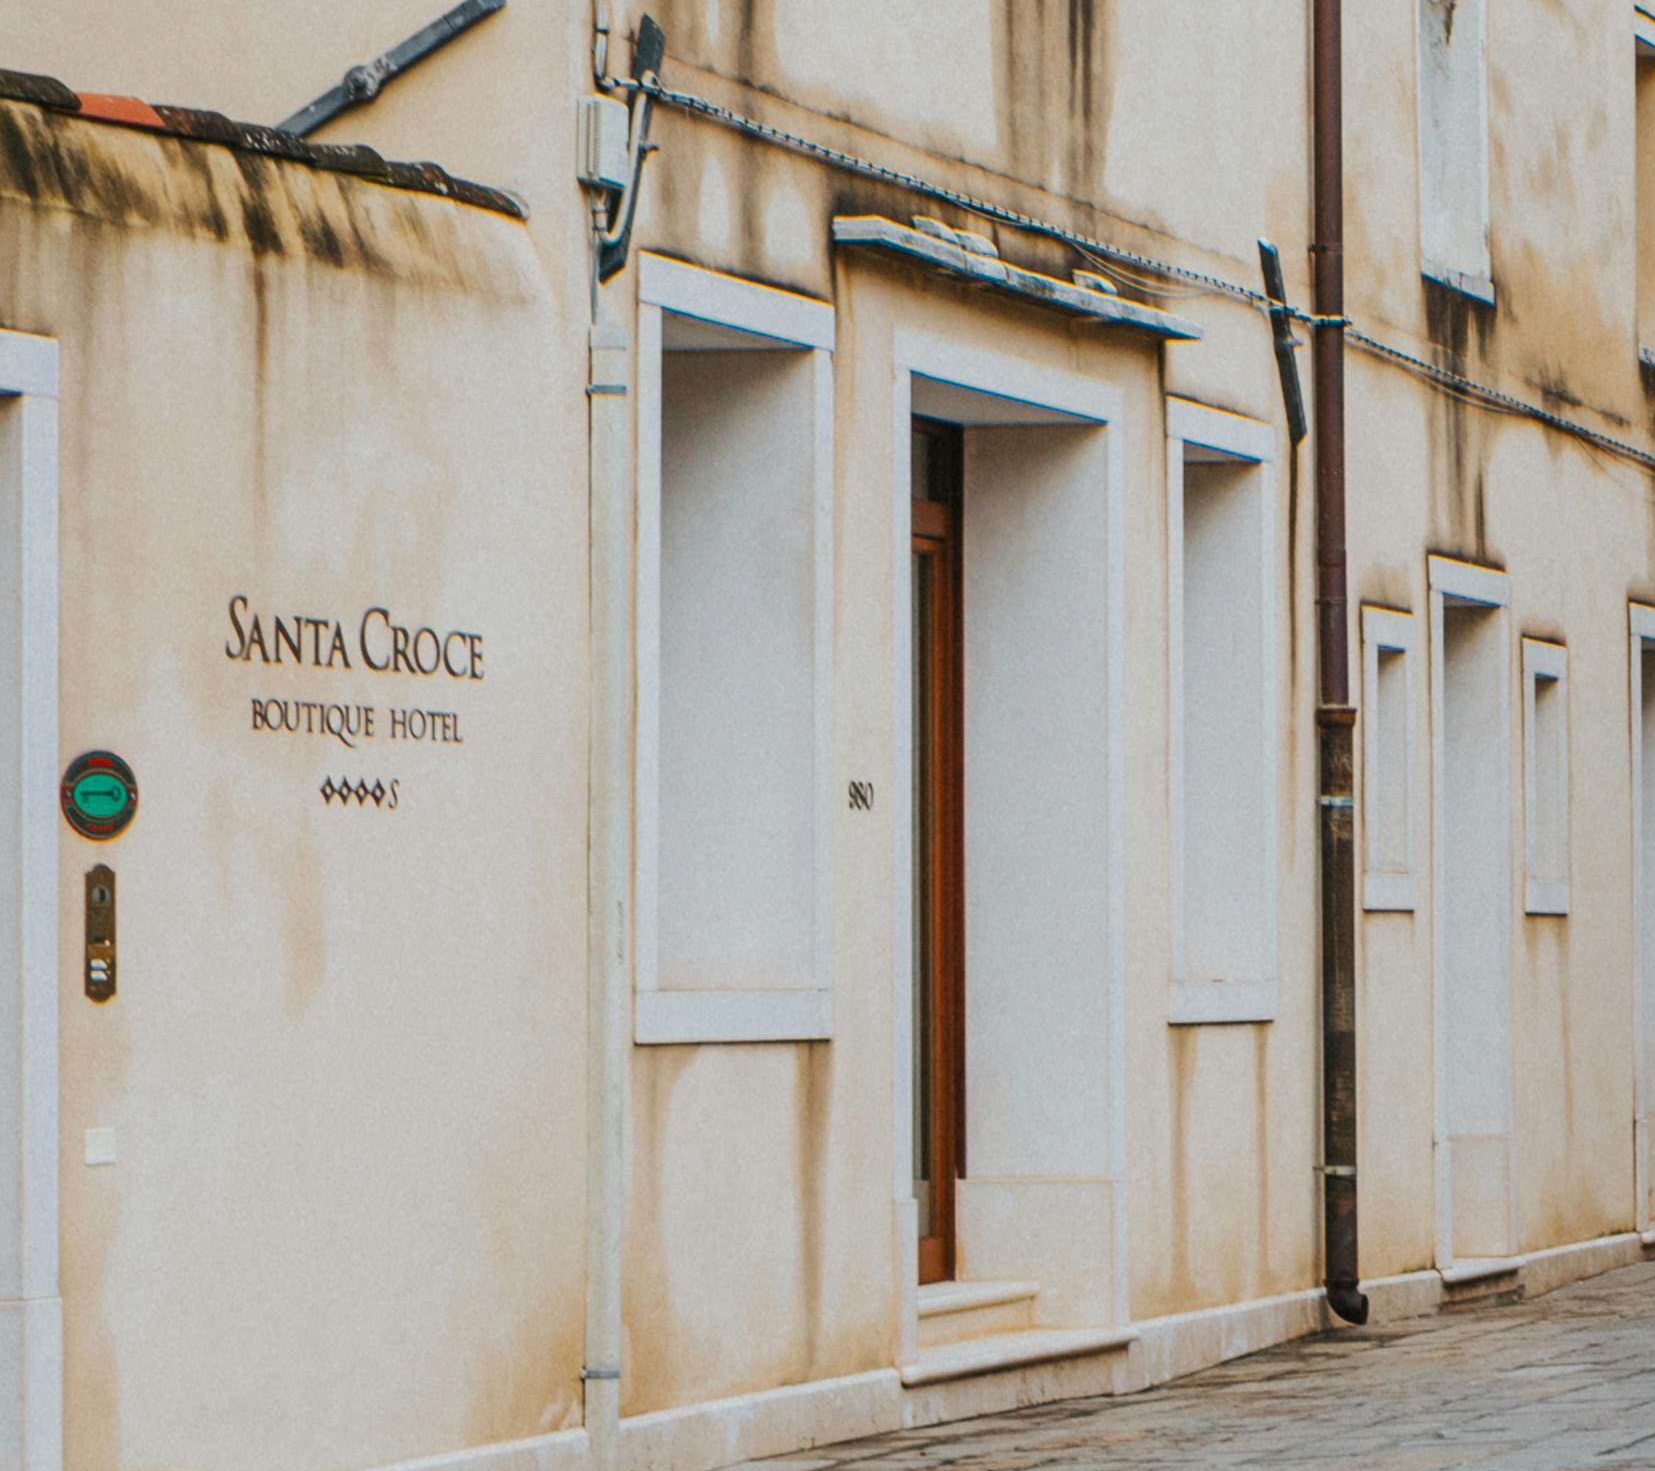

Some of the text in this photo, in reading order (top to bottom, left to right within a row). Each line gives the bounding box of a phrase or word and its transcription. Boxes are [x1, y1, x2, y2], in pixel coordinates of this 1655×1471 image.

[225, 594, 485, 680] SANTA CROCE
[251, 698, 464, 749] BOUTIQUE HOTEL
